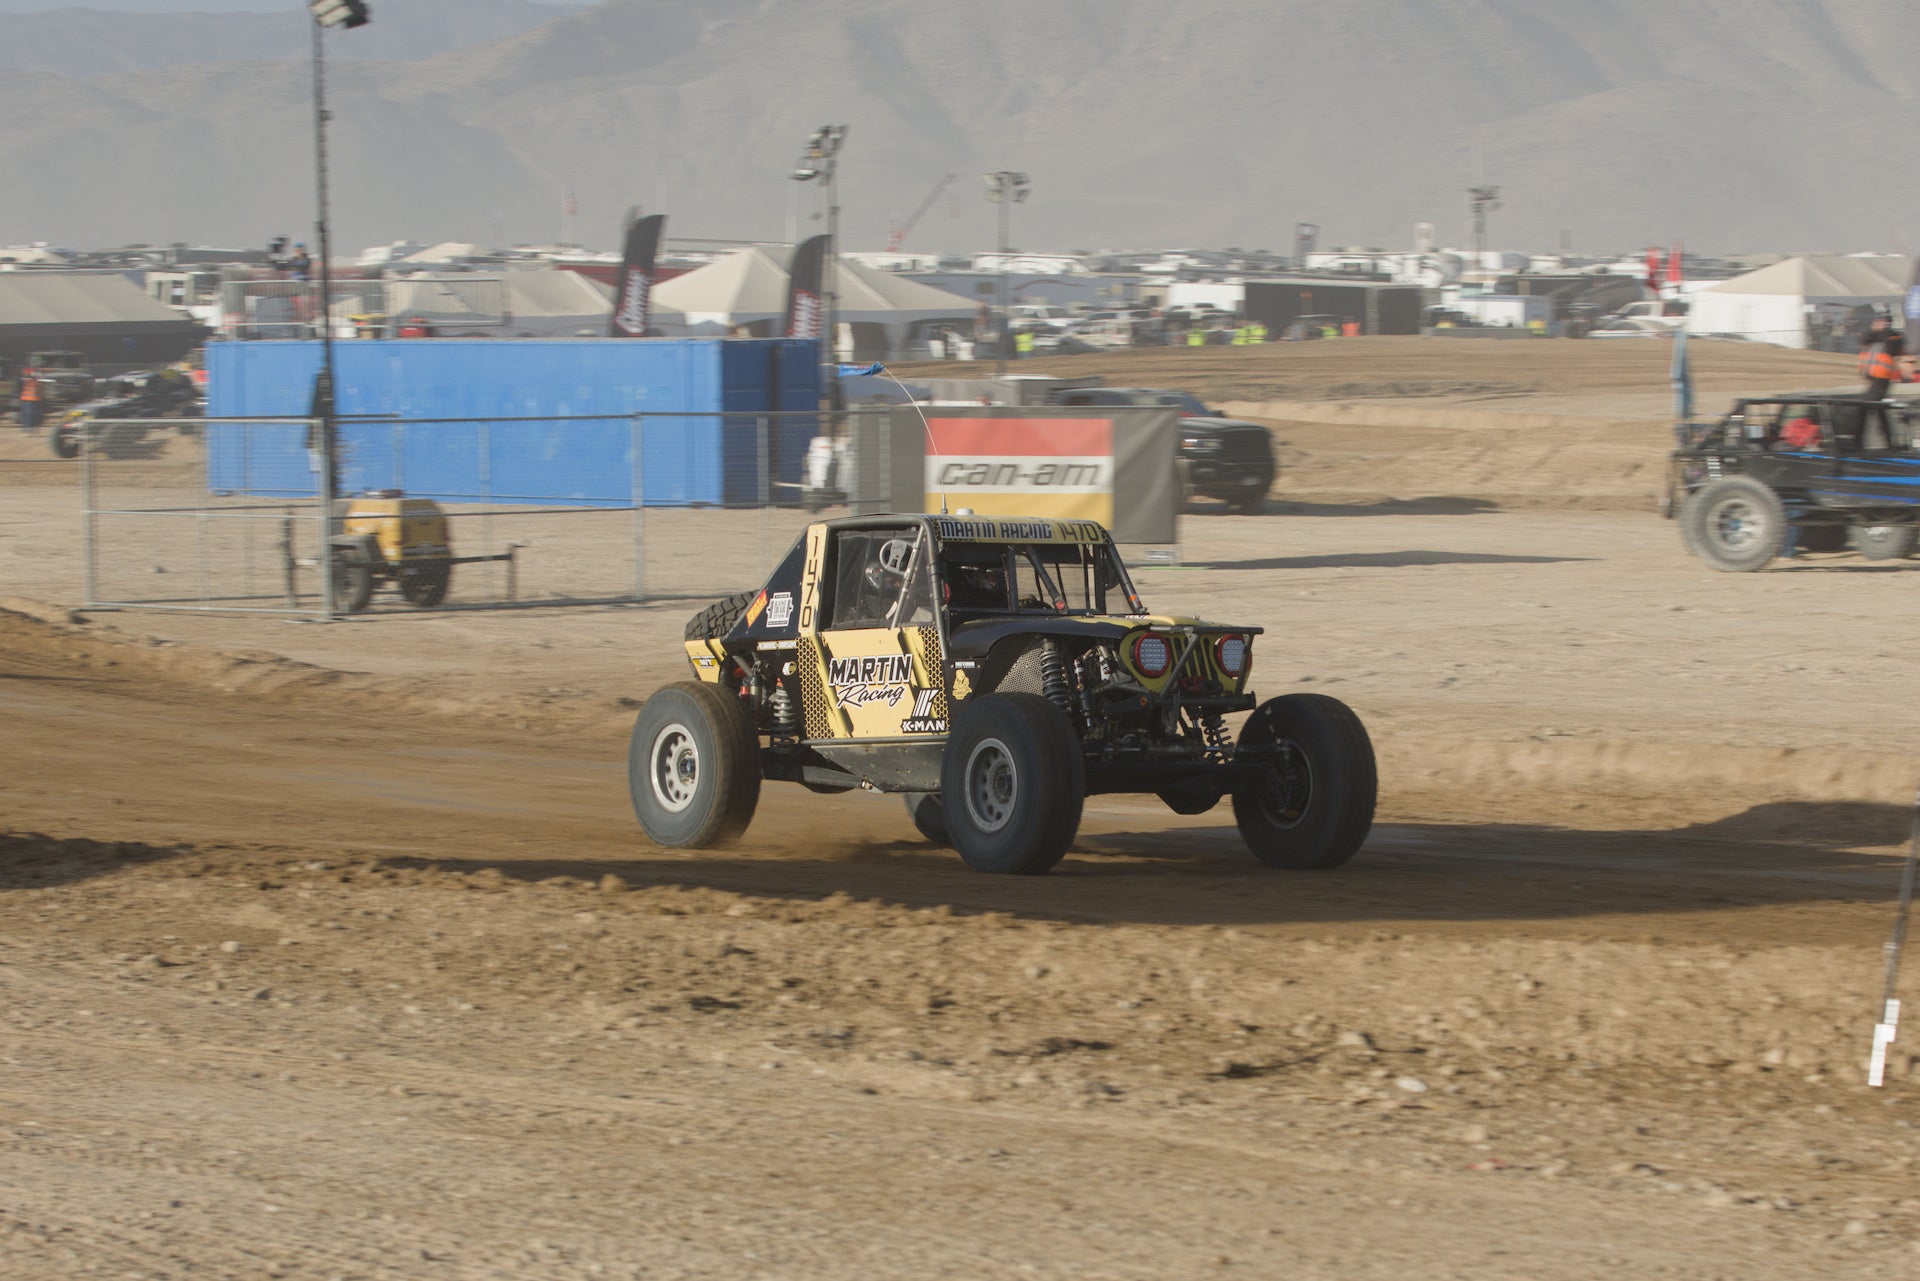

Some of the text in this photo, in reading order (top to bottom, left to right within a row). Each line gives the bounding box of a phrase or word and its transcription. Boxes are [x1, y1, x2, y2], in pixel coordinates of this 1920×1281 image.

[938, 463, 1101, 486] can-am
[941, 521, 1099, 541] MARTIN RACING 1470
[802, 535, 819, 628] 1470
[829, 654, 913, 686] MARTIN
[837, 683, 905, 708] Racing
